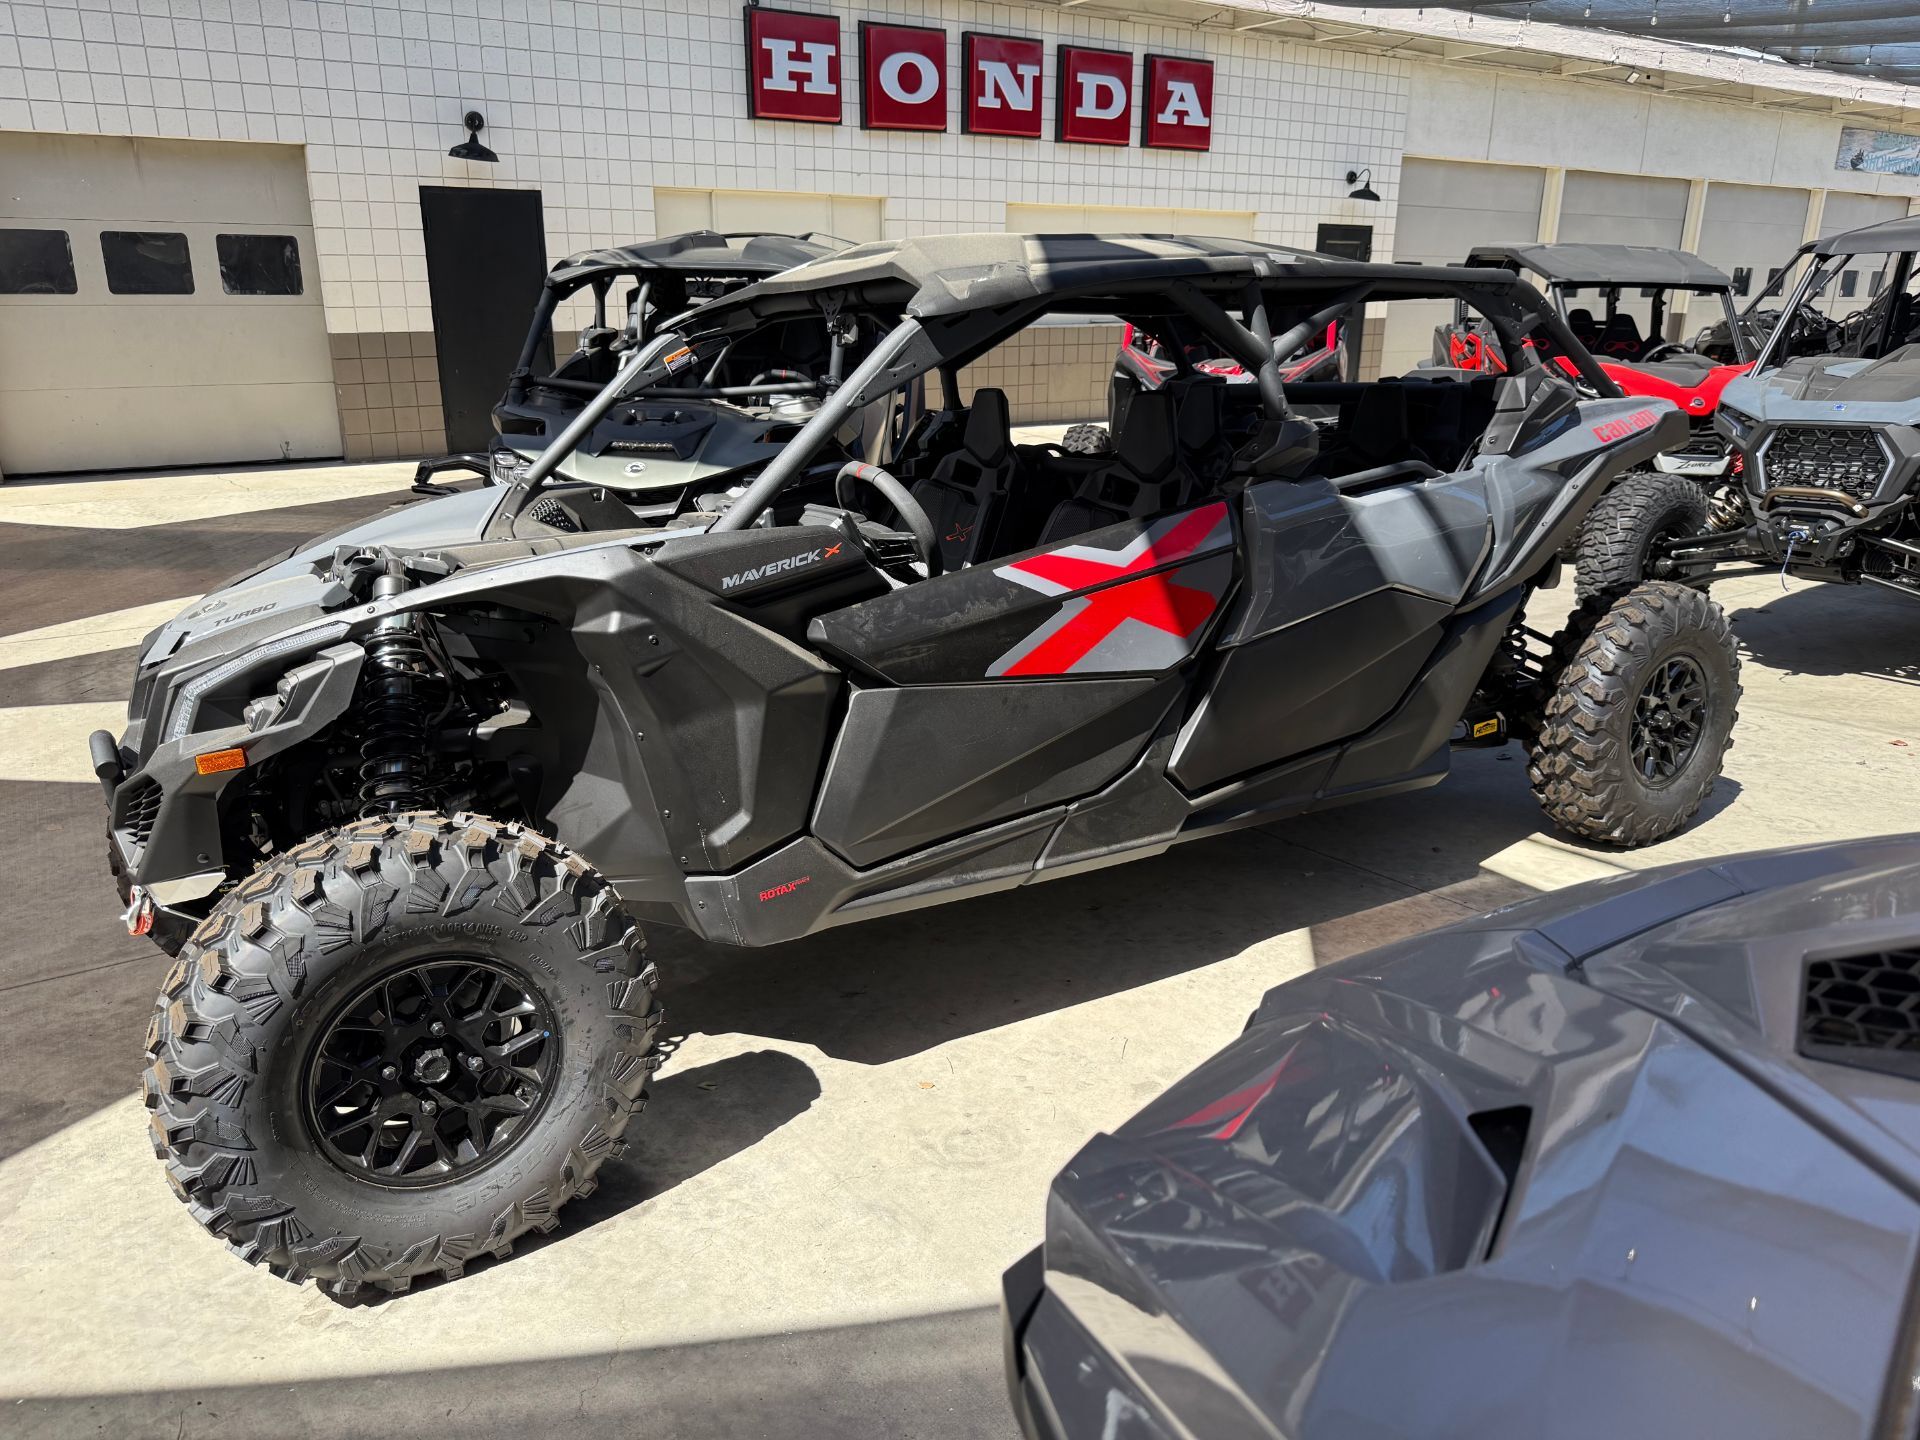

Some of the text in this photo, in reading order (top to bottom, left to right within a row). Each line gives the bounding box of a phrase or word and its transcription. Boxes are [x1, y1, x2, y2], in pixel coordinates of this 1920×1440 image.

[761, 37, 1209, 127] HONDA
[721, 548, 821, 590] MAVERICK
[213, 602, 278, 627] TURBO
[759, 882, 796, 902] ROTAX
